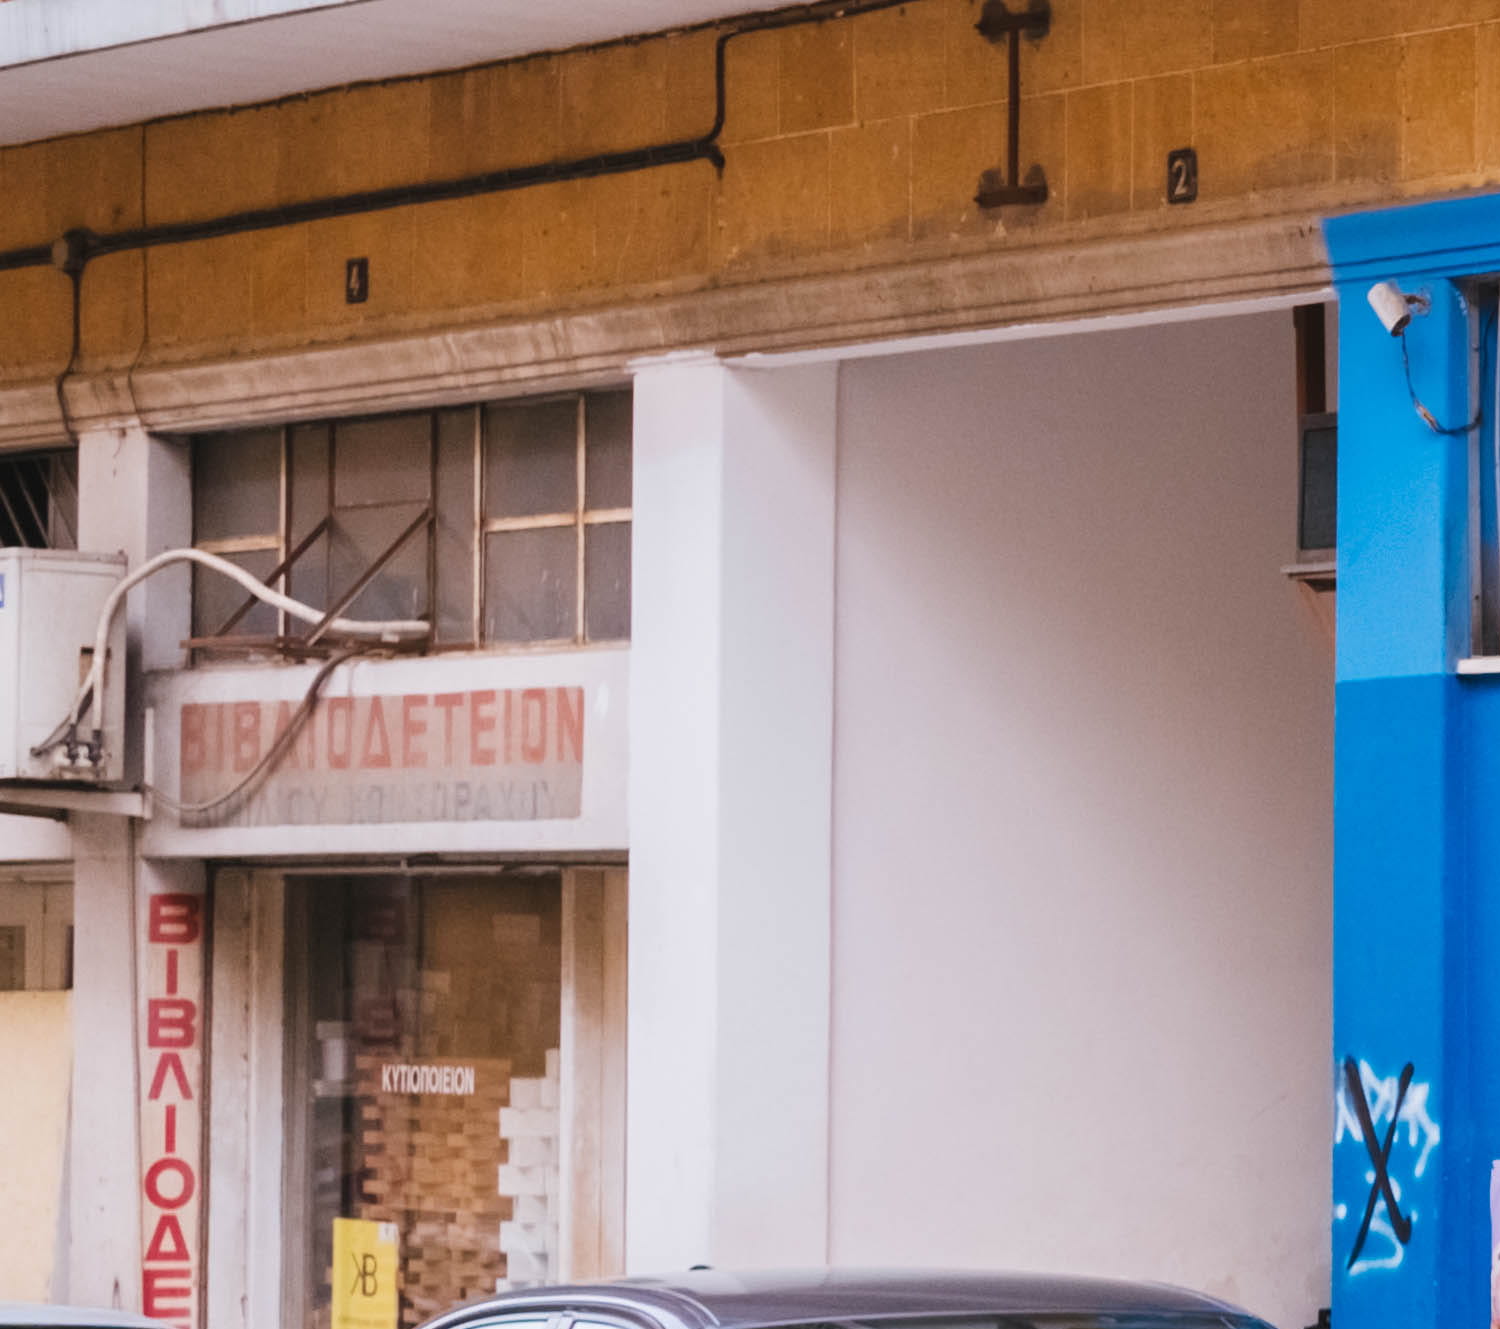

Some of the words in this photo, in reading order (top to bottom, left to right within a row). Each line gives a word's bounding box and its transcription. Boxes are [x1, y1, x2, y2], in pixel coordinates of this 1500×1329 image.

[1174, 162, 1189, 196] 2
[349, 265, 360, 296] 4
[381, 1063, 476, 1096] ΚΥΤΙΟΠΟΙΕΙΟΝ
